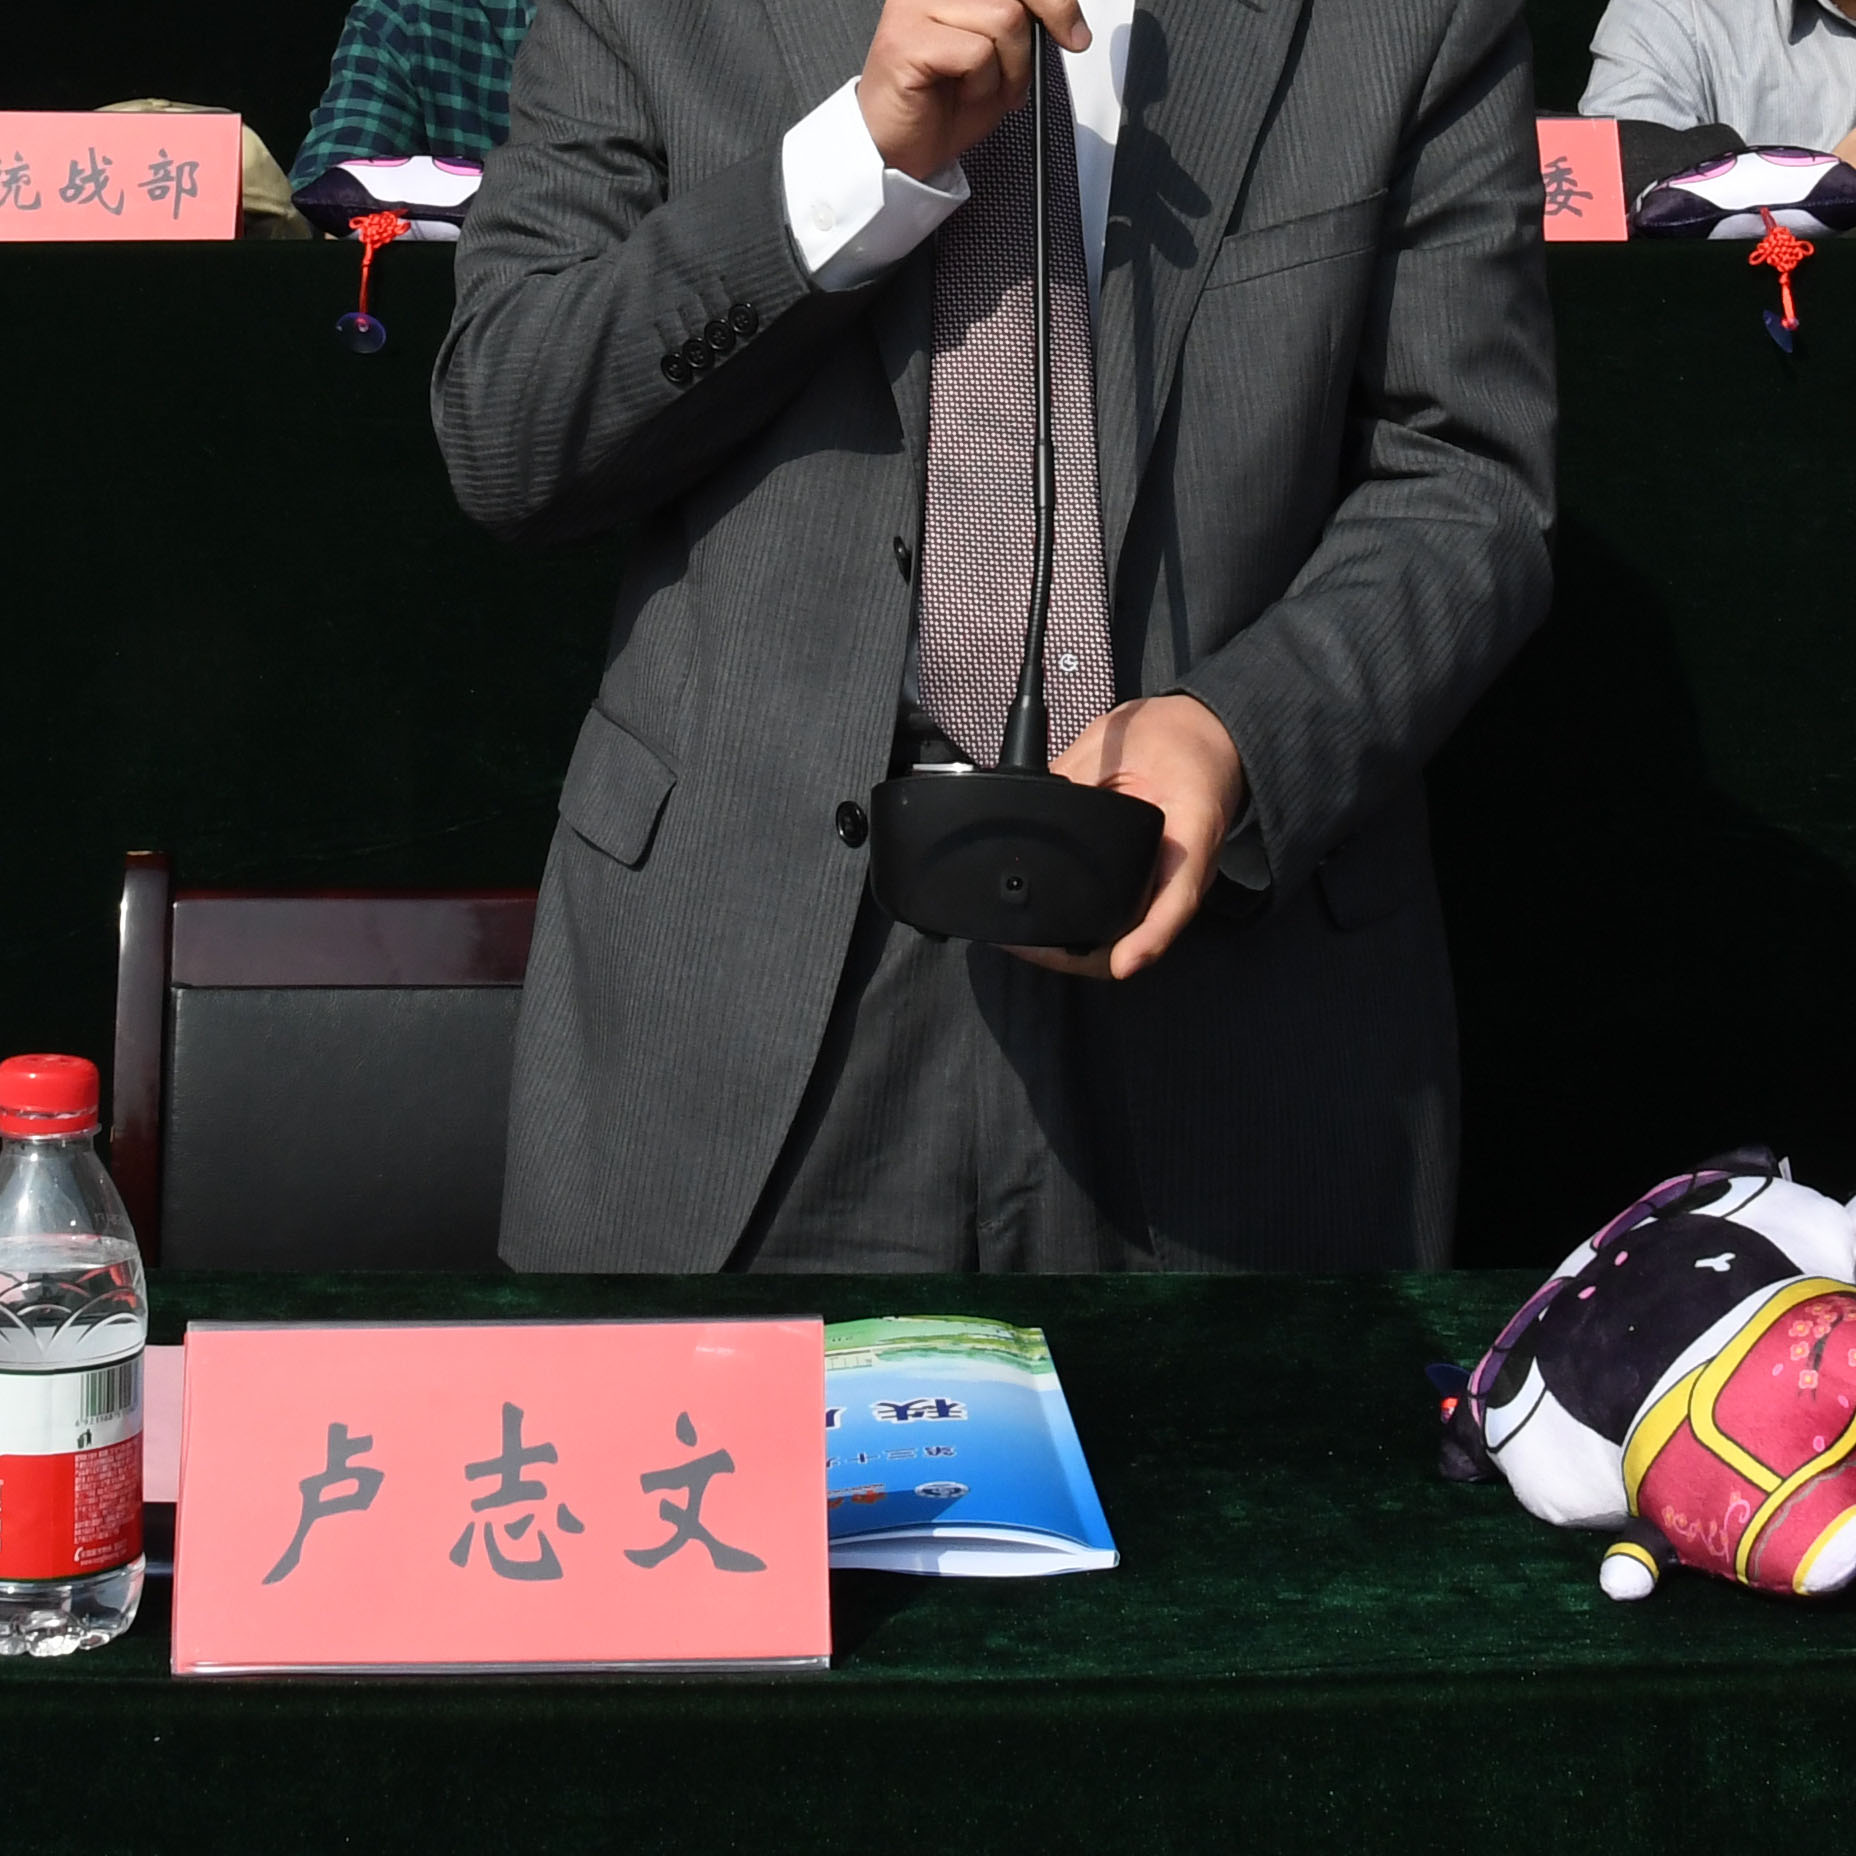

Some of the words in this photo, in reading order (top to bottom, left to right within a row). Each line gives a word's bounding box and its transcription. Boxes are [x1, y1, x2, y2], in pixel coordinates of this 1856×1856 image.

[826, 1397, 968, 1427] 秩
[263, 1402, 768, 1584] 卢志文
